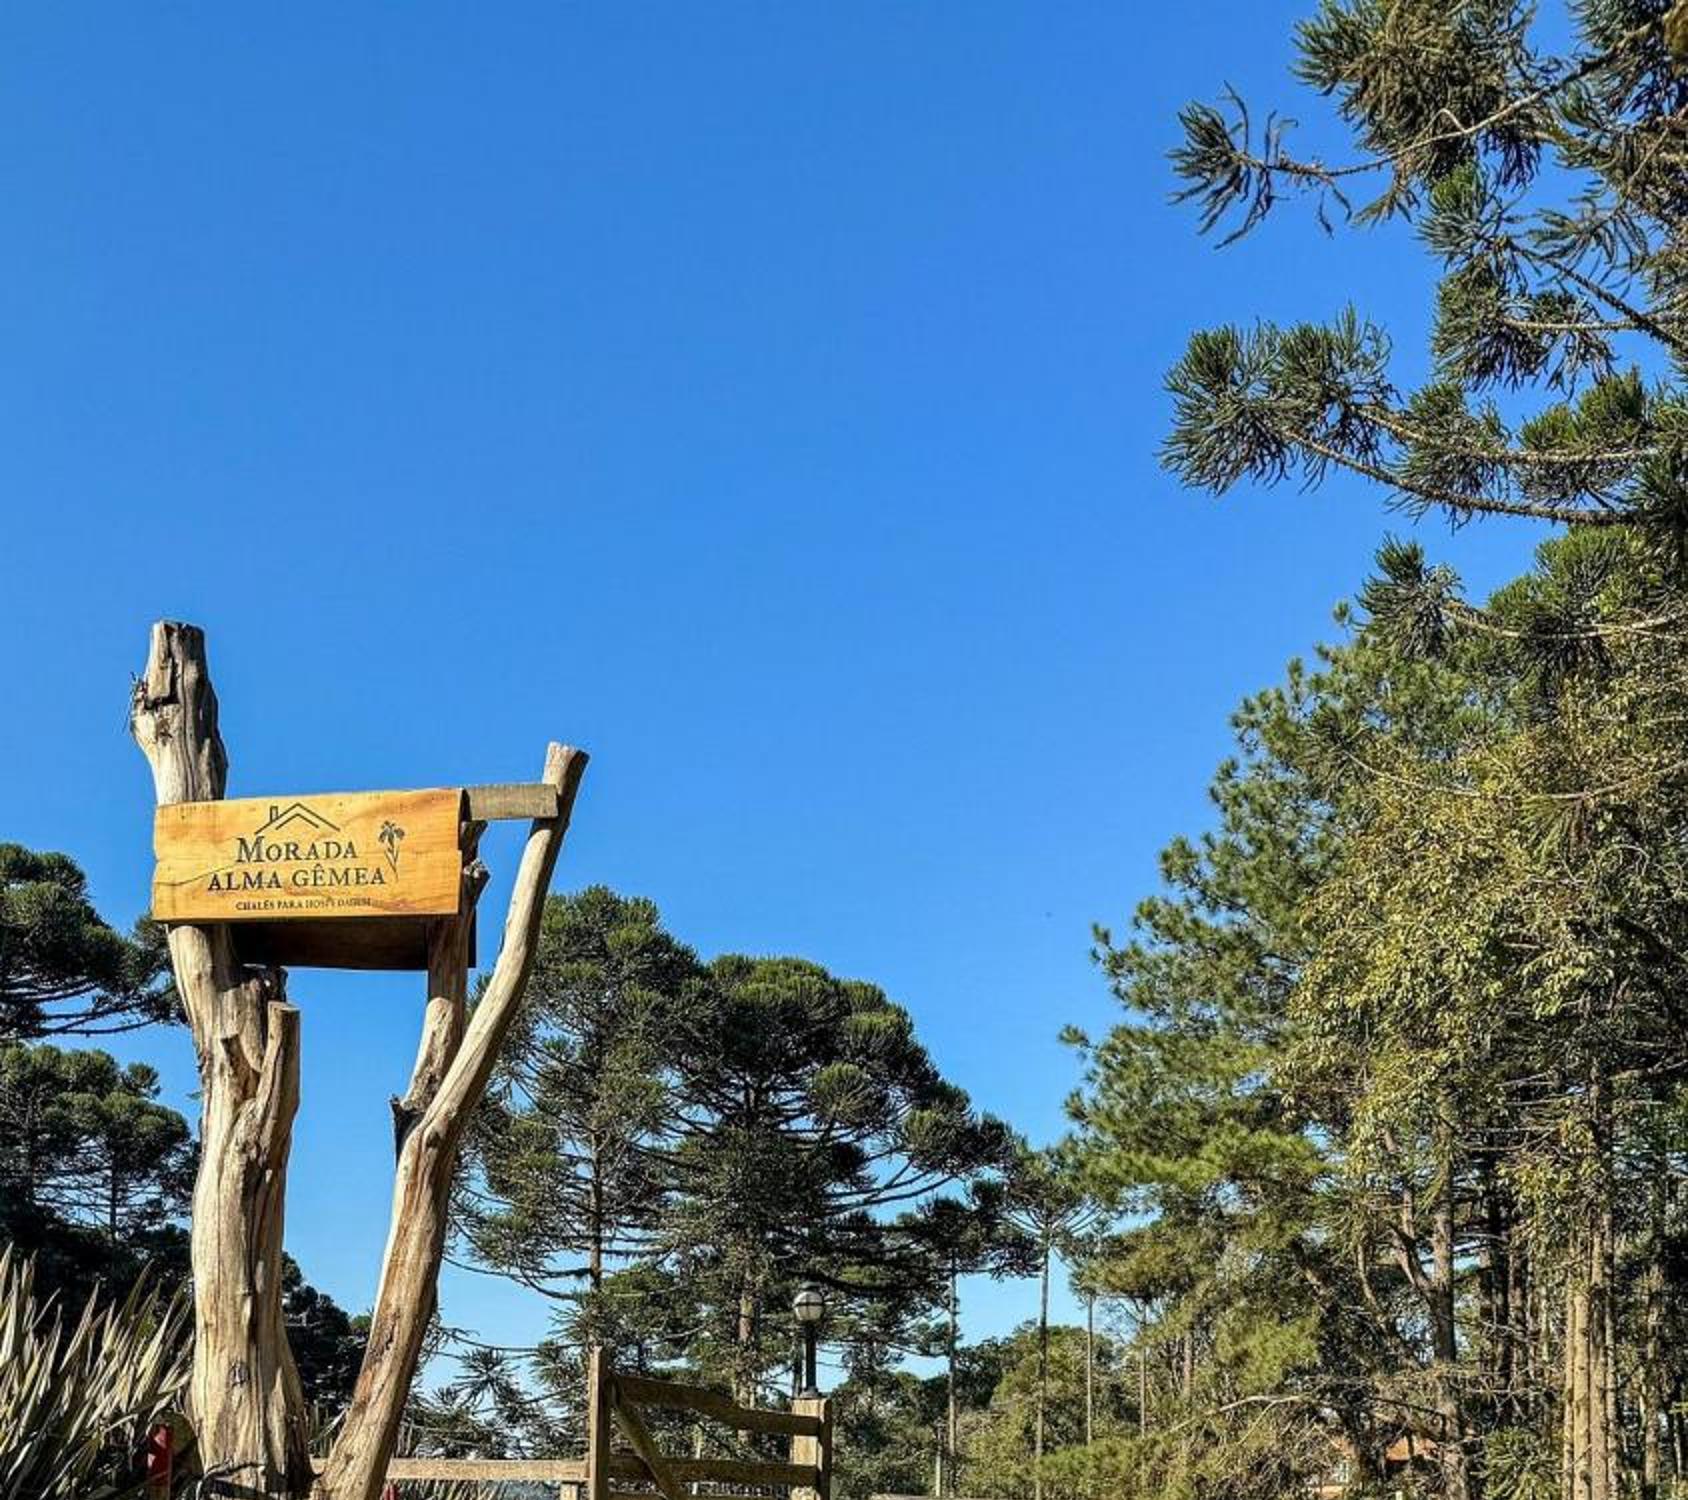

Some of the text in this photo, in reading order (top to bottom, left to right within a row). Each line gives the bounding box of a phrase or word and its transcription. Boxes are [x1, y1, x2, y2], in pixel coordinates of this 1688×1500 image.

[207, 863, 386, 891] ALMA GÊMEA
[277, 899, 303, 910] PARA
